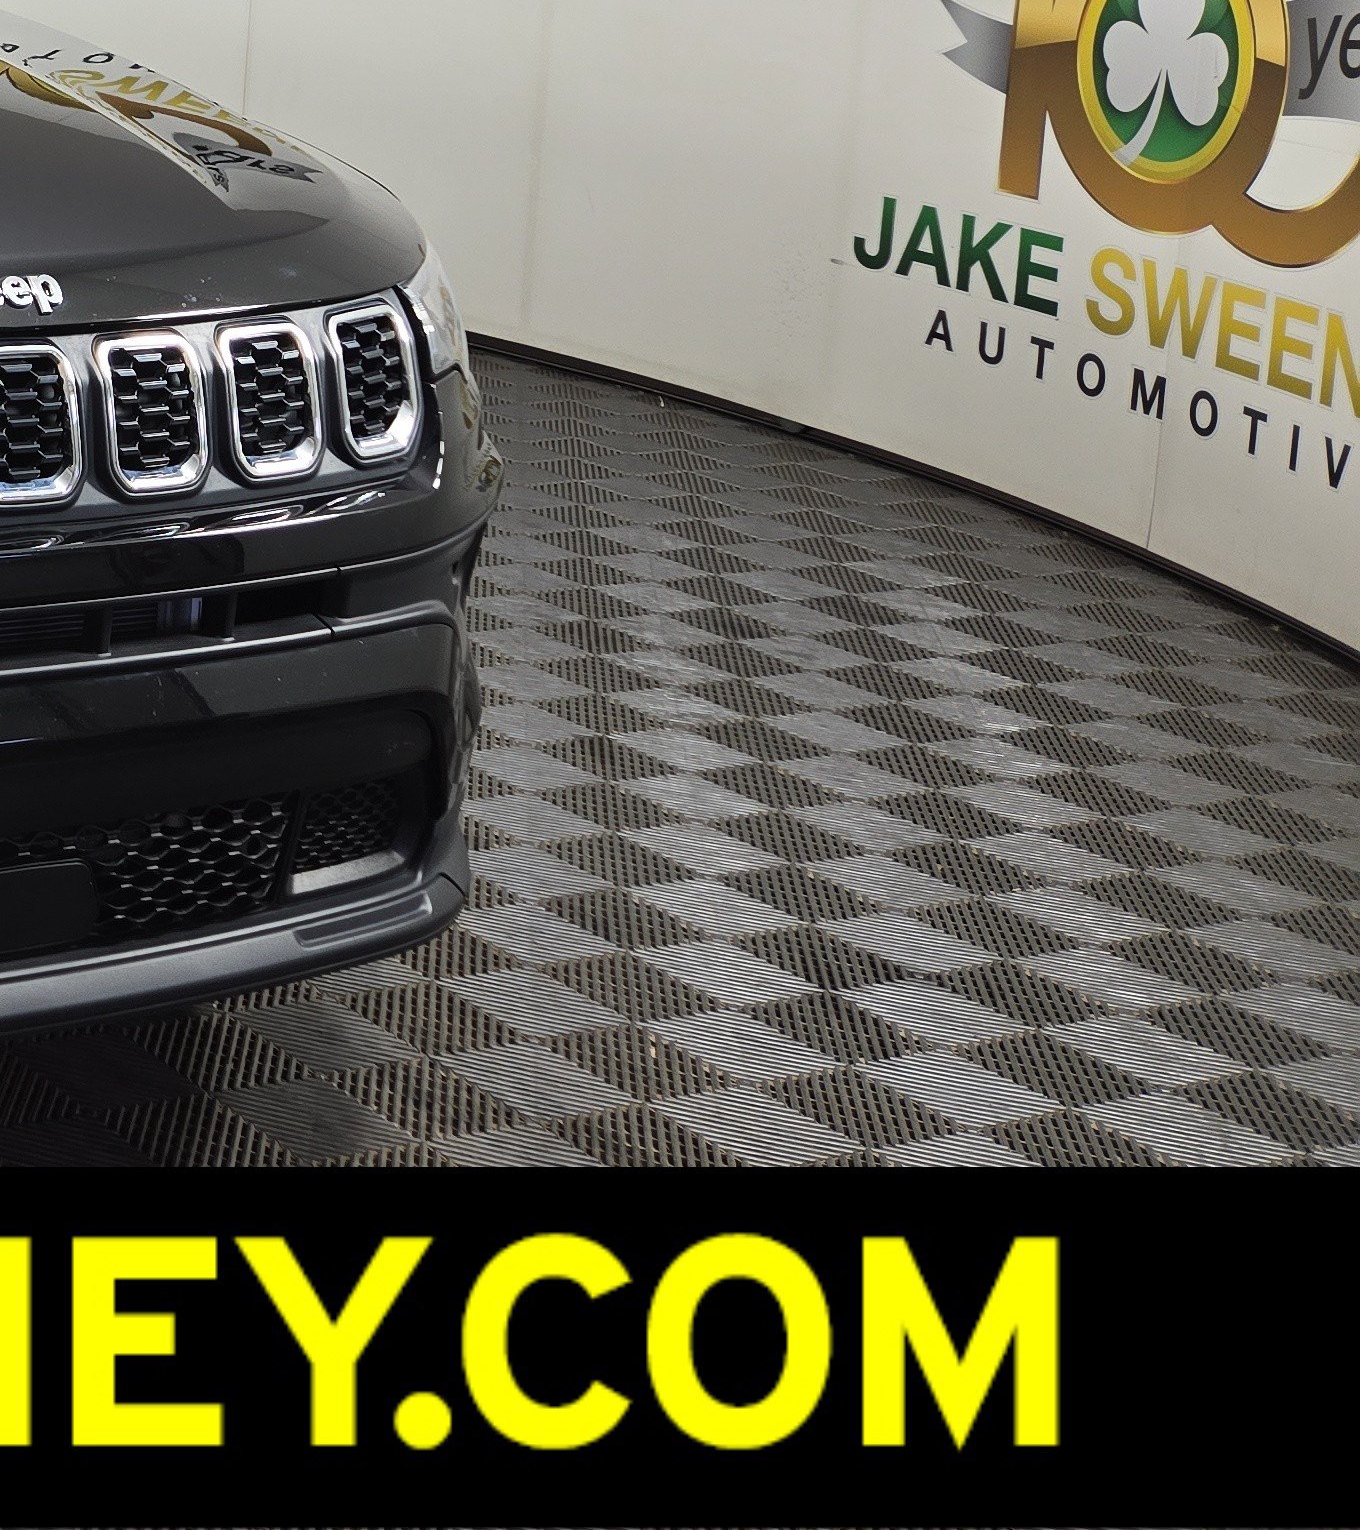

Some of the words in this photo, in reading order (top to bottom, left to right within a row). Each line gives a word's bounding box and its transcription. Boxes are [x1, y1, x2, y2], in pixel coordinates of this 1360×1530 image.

[853, 195, 1065, 318] JAKE
[1084, 247, 1360, 419] SWEEN
[925, 309, 1352, 491] AUTOMOTIV
